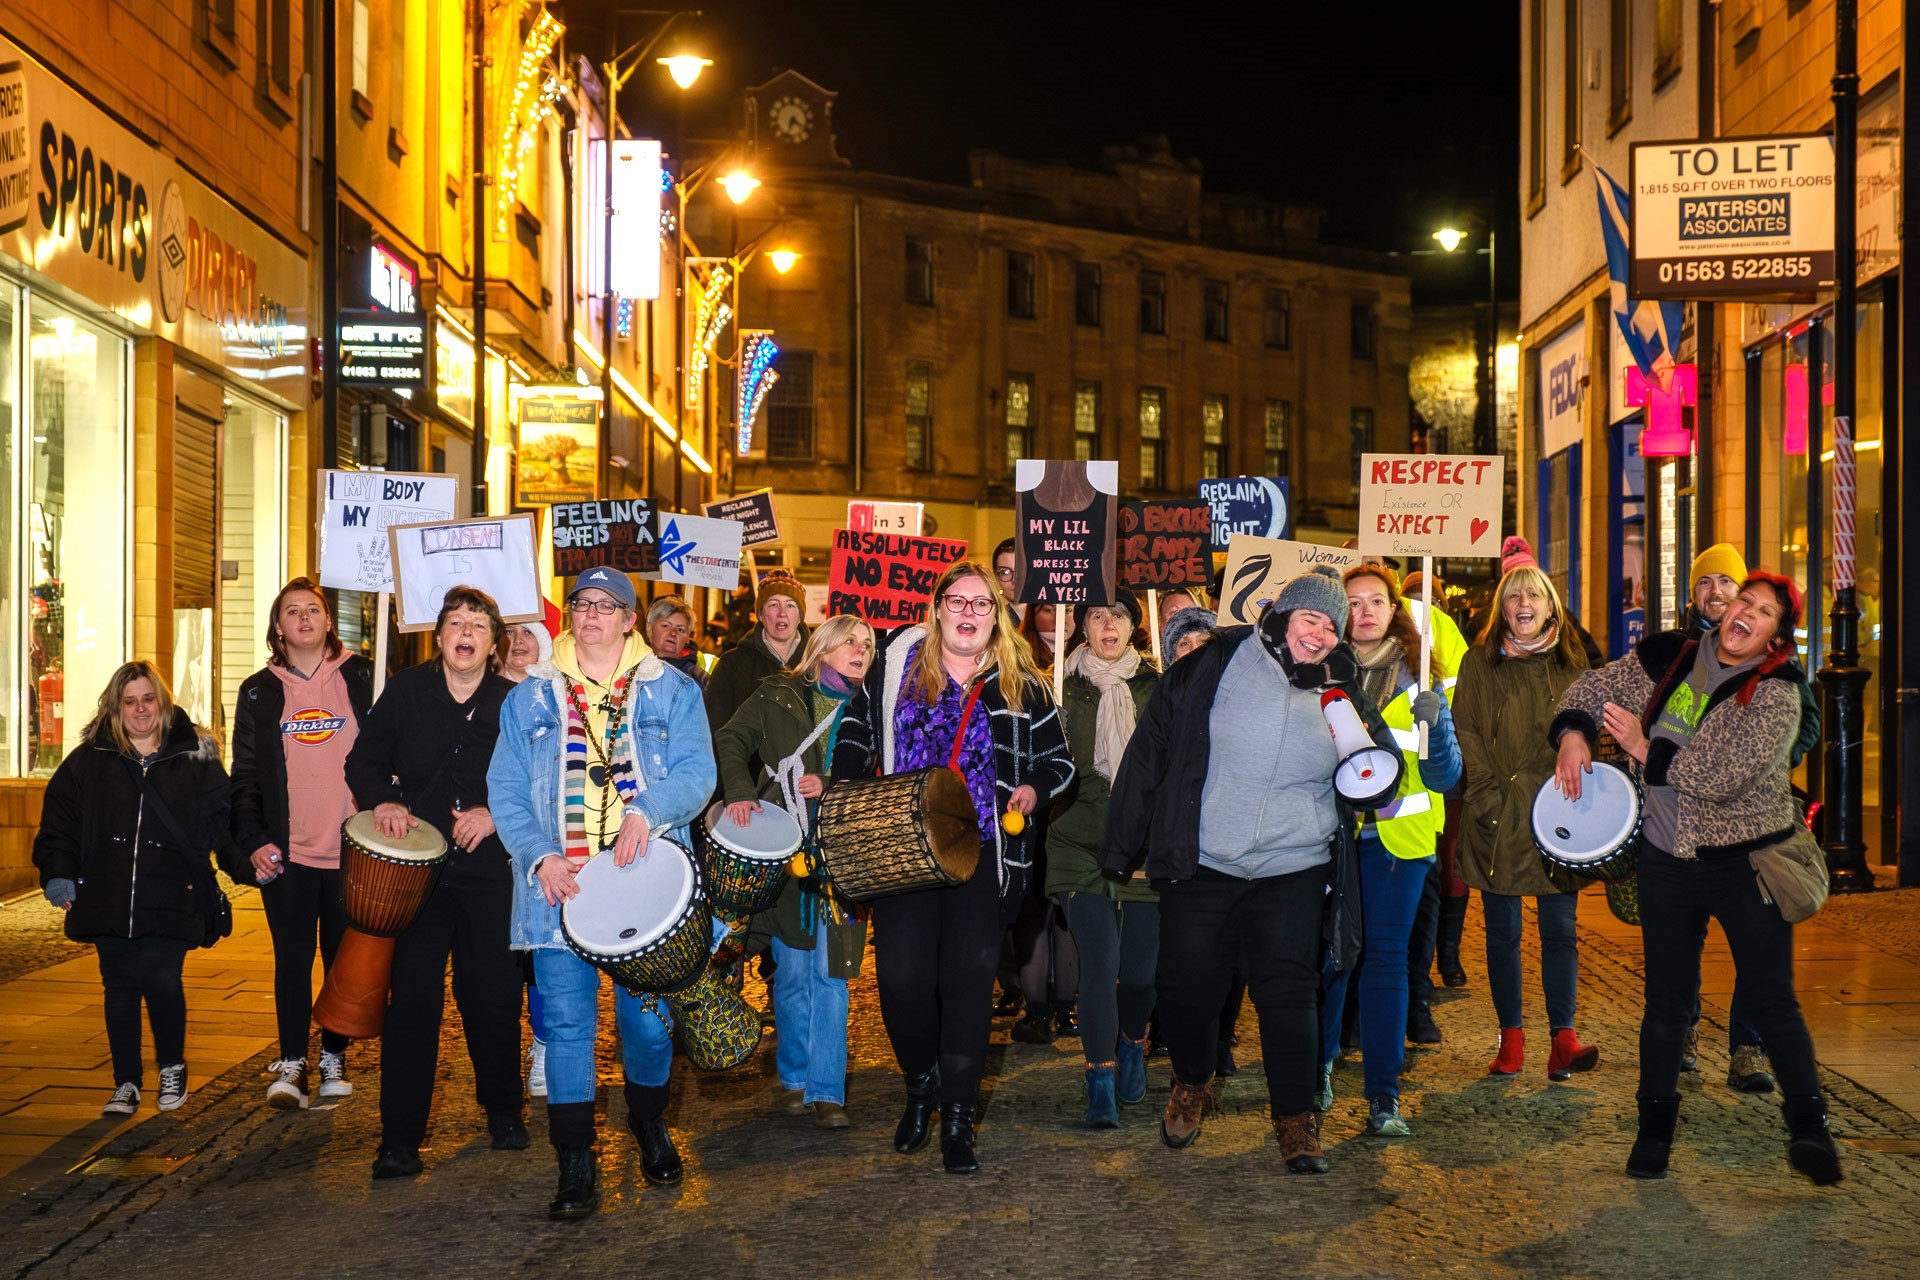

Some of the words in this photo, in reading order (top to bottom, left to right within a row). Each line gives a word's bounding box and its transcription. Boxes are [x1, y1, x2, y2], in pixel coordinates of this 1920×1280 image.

[0, 83, 23, 119] RDER
[0, 126, 25, 164] NLINE
[1670, 147, 1719, 177] TO
[1733, 143, 1801, 174] LET
[0, 169, 28, 209] NYTIME
[1639, 180, 1669, 196] 1,815
[1672, 180, 1708, 194] SQ.FT
[1711, 179, 1745, 192] OVER
[1749, 177, 1778, 189] TWO
[1780, 175, 1833, 188] FLOORS
[37, 119, 148, 283] SPORTS
[1684, 198, 1785, 219] PATERSON
[1683, 216, 1787, 236] ASSOCIATES
[1659, 261, 1725, 283] 01563
[1731, 257, 1812, 280] 522855
[1371, 460, 1492, 485] RESPECT
[344, 474, 375, 500] MY
[382, 478, 425, 502] BODY
[1200, 482, 1265, 504] RECLAIM
[721, 499, 754, 513] RECLAIM
[1382, 489, 1427, 510] Existence
[1440, 493, 1463, 509] OR
[342, 505, 371, 527] MY
[553, 500, 650, 527] FEELING
[736, 507, 760, 520] NIGHT
[874, 515, 888, 528] in
[897, 516, 905, 529] 3
[1118, 507, 1139, 533] O
[1208, 502, 1230, 522] THE
[743, 520, 769, 533] LENCE
[1029, 519, 1055, 535] MY
[1063, 519, 1090, 534] LIL
[1376, 514, 1450, 535] EXPECT
[553, 525, 593, 547] SAFE
[593, 524, 610, 545] IS
[636, 525, 654, 544] A
[747, 529, 776, 542] WOMEN
[837, 530, 966, 562] ABSOLUTELY
[1044, 540, 1085, 551] BLACK
[1299, 546, 1354, 565] Women
[1392, 540, 1432, 554] Resistance
[447, 555, 472, 575] IS
[844, 556, 882, 587] NO
[1033, 559, 1070, 569] DRESS
[1073, 559, 1089, 569] IS
[1048, 572, 1084, 585] NOT
[1037, 586, 1047, 600] A
[1055, 586, 1087, 601] YES!
[285, 720, 341, 731] Dickies
